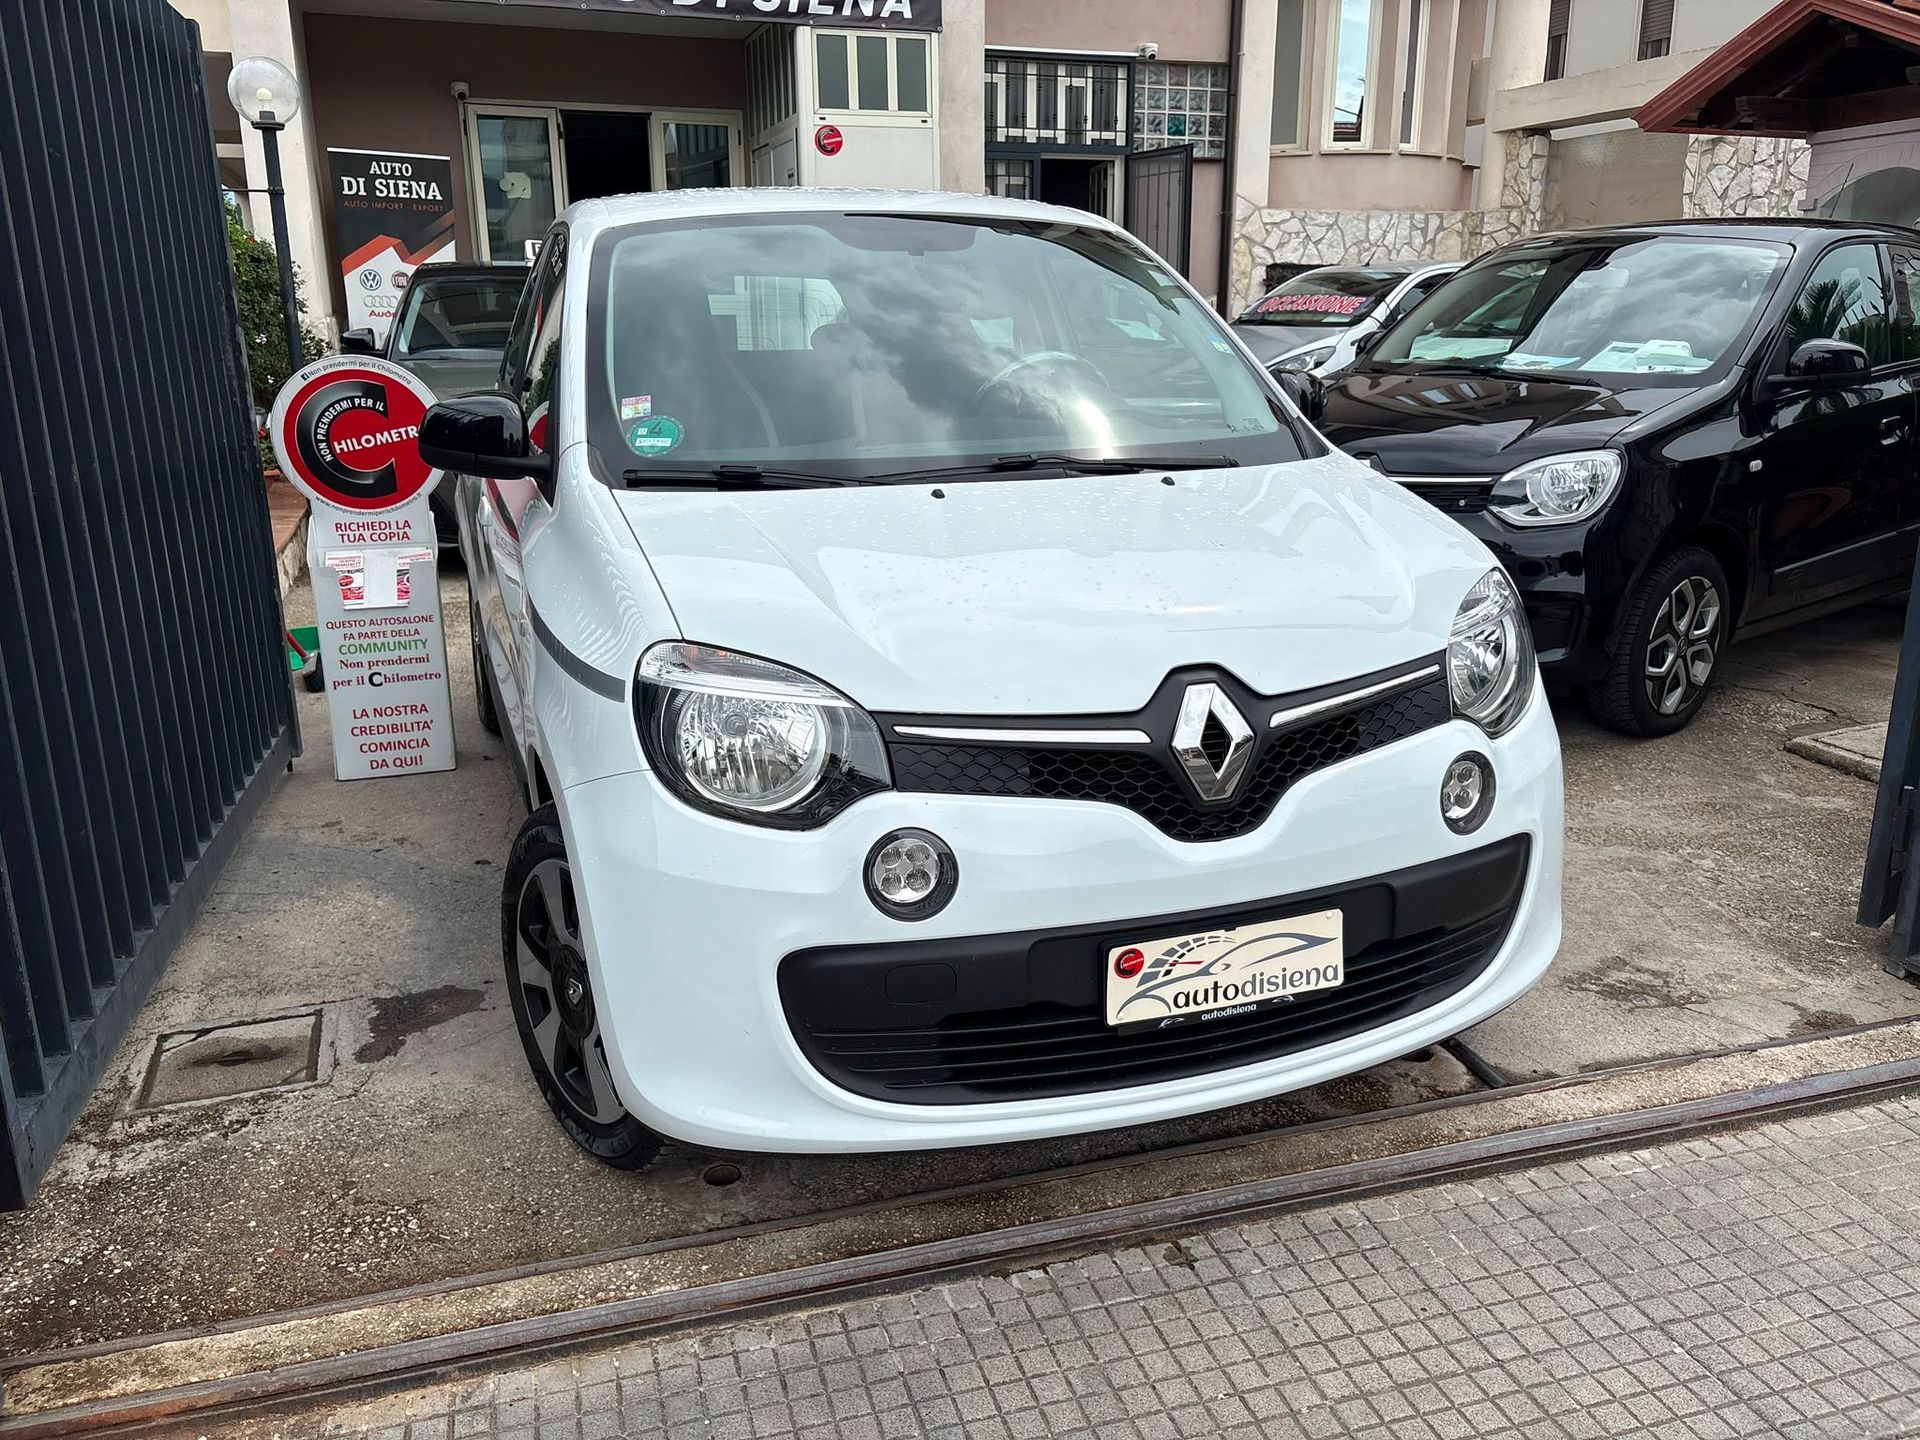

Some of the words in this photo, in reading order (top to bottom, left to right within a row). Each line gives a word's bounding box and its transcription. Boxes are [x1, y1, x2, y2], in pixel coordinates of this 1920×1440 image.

[369, 161, 412, 177] AUTO
[341, 176, 367, 196] DI
[375, 179, 443, 200] SIENA
[343, 201, 368, 209] AUTO
[372, 202, 404, 210] IMPORT
[413, 204, 444, 212] EXPORT
[1257, 294, 1366, 314] OCCASIONE
[308, 368, 322, 377] Non
[322, 360, 357, 371] prendermi
[359, 361, 370, 369] per
[371, 361, 376, 369] il
[377, 364, 412, 385] Chilometro
[354, 397, 373, 407] PER
[375, 401, 385, 412] IL
[317, 399, 353, 441] PRENDERMI
[649, 421, 663, 436] 4
[333, 425, 419, 454] HILOMETR
[317, 441, 334, 463] NON
[335, 521, 392, 533] RICHIEDI
[396, 520, 412, 530] LA
[338, 533, 366, 544] TUA
[370, 531, 410, 542] COPIA
[325, 619, 366, 629] QUESTO
[369, 615, 434, 626] AUTOSALONE
[343, 632, 355, 641] FA
[358, 630, 388, 640] PARTE
[390, 628, 420, 638] DELLA
[338, 639, 428, 655] COMMUNITY
[339, 659, 364, 670] Non
[367, 654, 430, 670] prendermi
[332, 678, 353, 690] per
[356, 676, 365, 686] il
[368, 672, 441, 687] Chilometro
[353, 709, 369, 719] LA
[373, 704, 429, 718] NOSTRA
[359, 738, 430, 753] COMINCIA
[369, 759, 389, 770] DA
[393, 755, 423, 768] QUI!
[1173, 963, 1338, 1009] autodisiena
[1201, 1003, 1257, 1021] autodisiena
